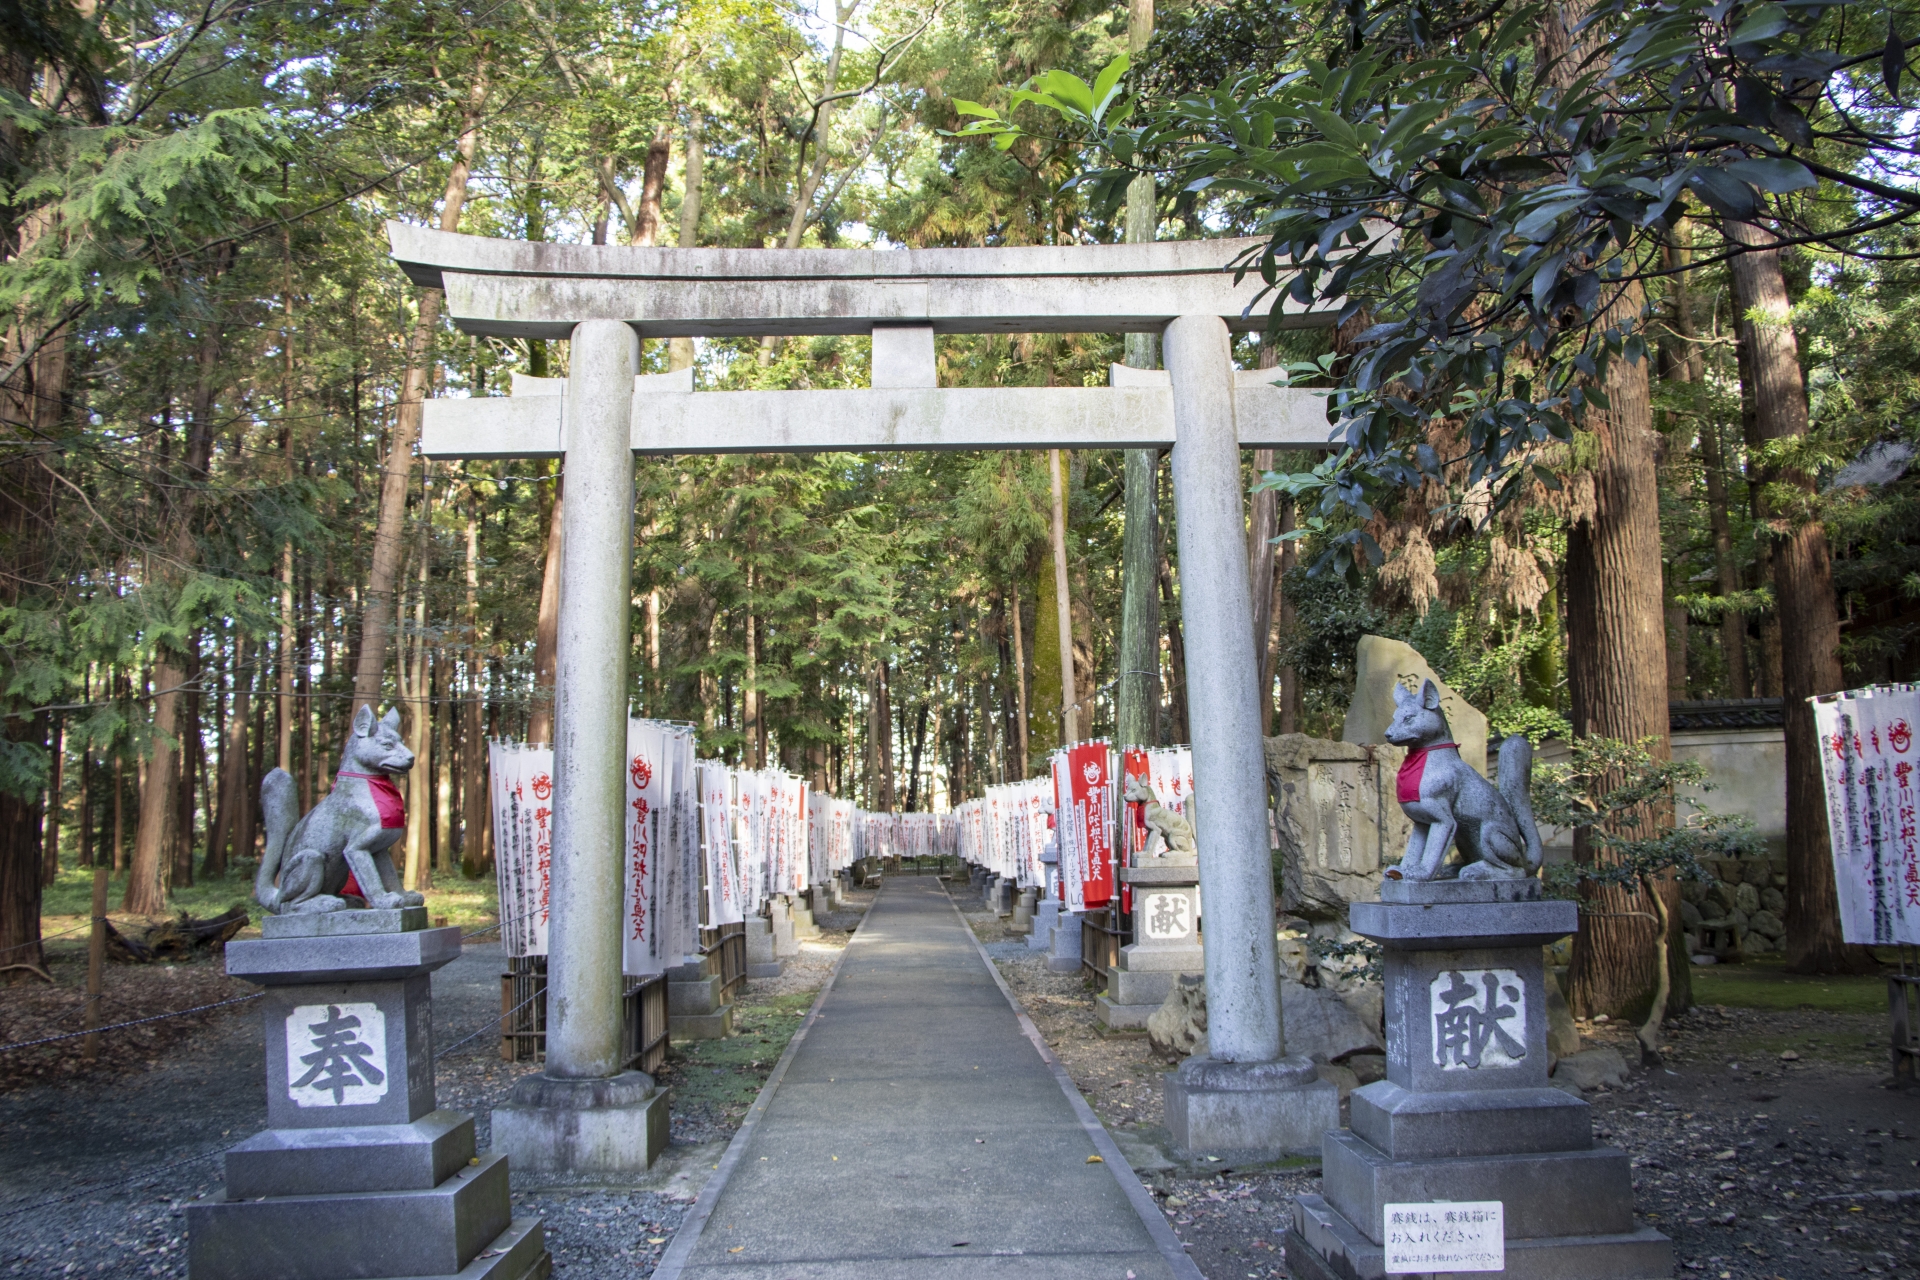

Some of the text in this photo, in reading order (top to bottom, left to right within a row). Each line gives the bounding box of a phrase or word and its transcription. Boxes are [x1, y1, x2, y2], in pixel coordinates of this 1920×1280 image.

[1151, 895, 1187, 934] 献
[1435, 972, 1526, 1069] 献
[290, 1005, 385, 1105] 奉
[1391, 1211, 1496, 1224] 賽銭は、賽銭箱に
[1391, 1231, 1481, 1243] お入れください
